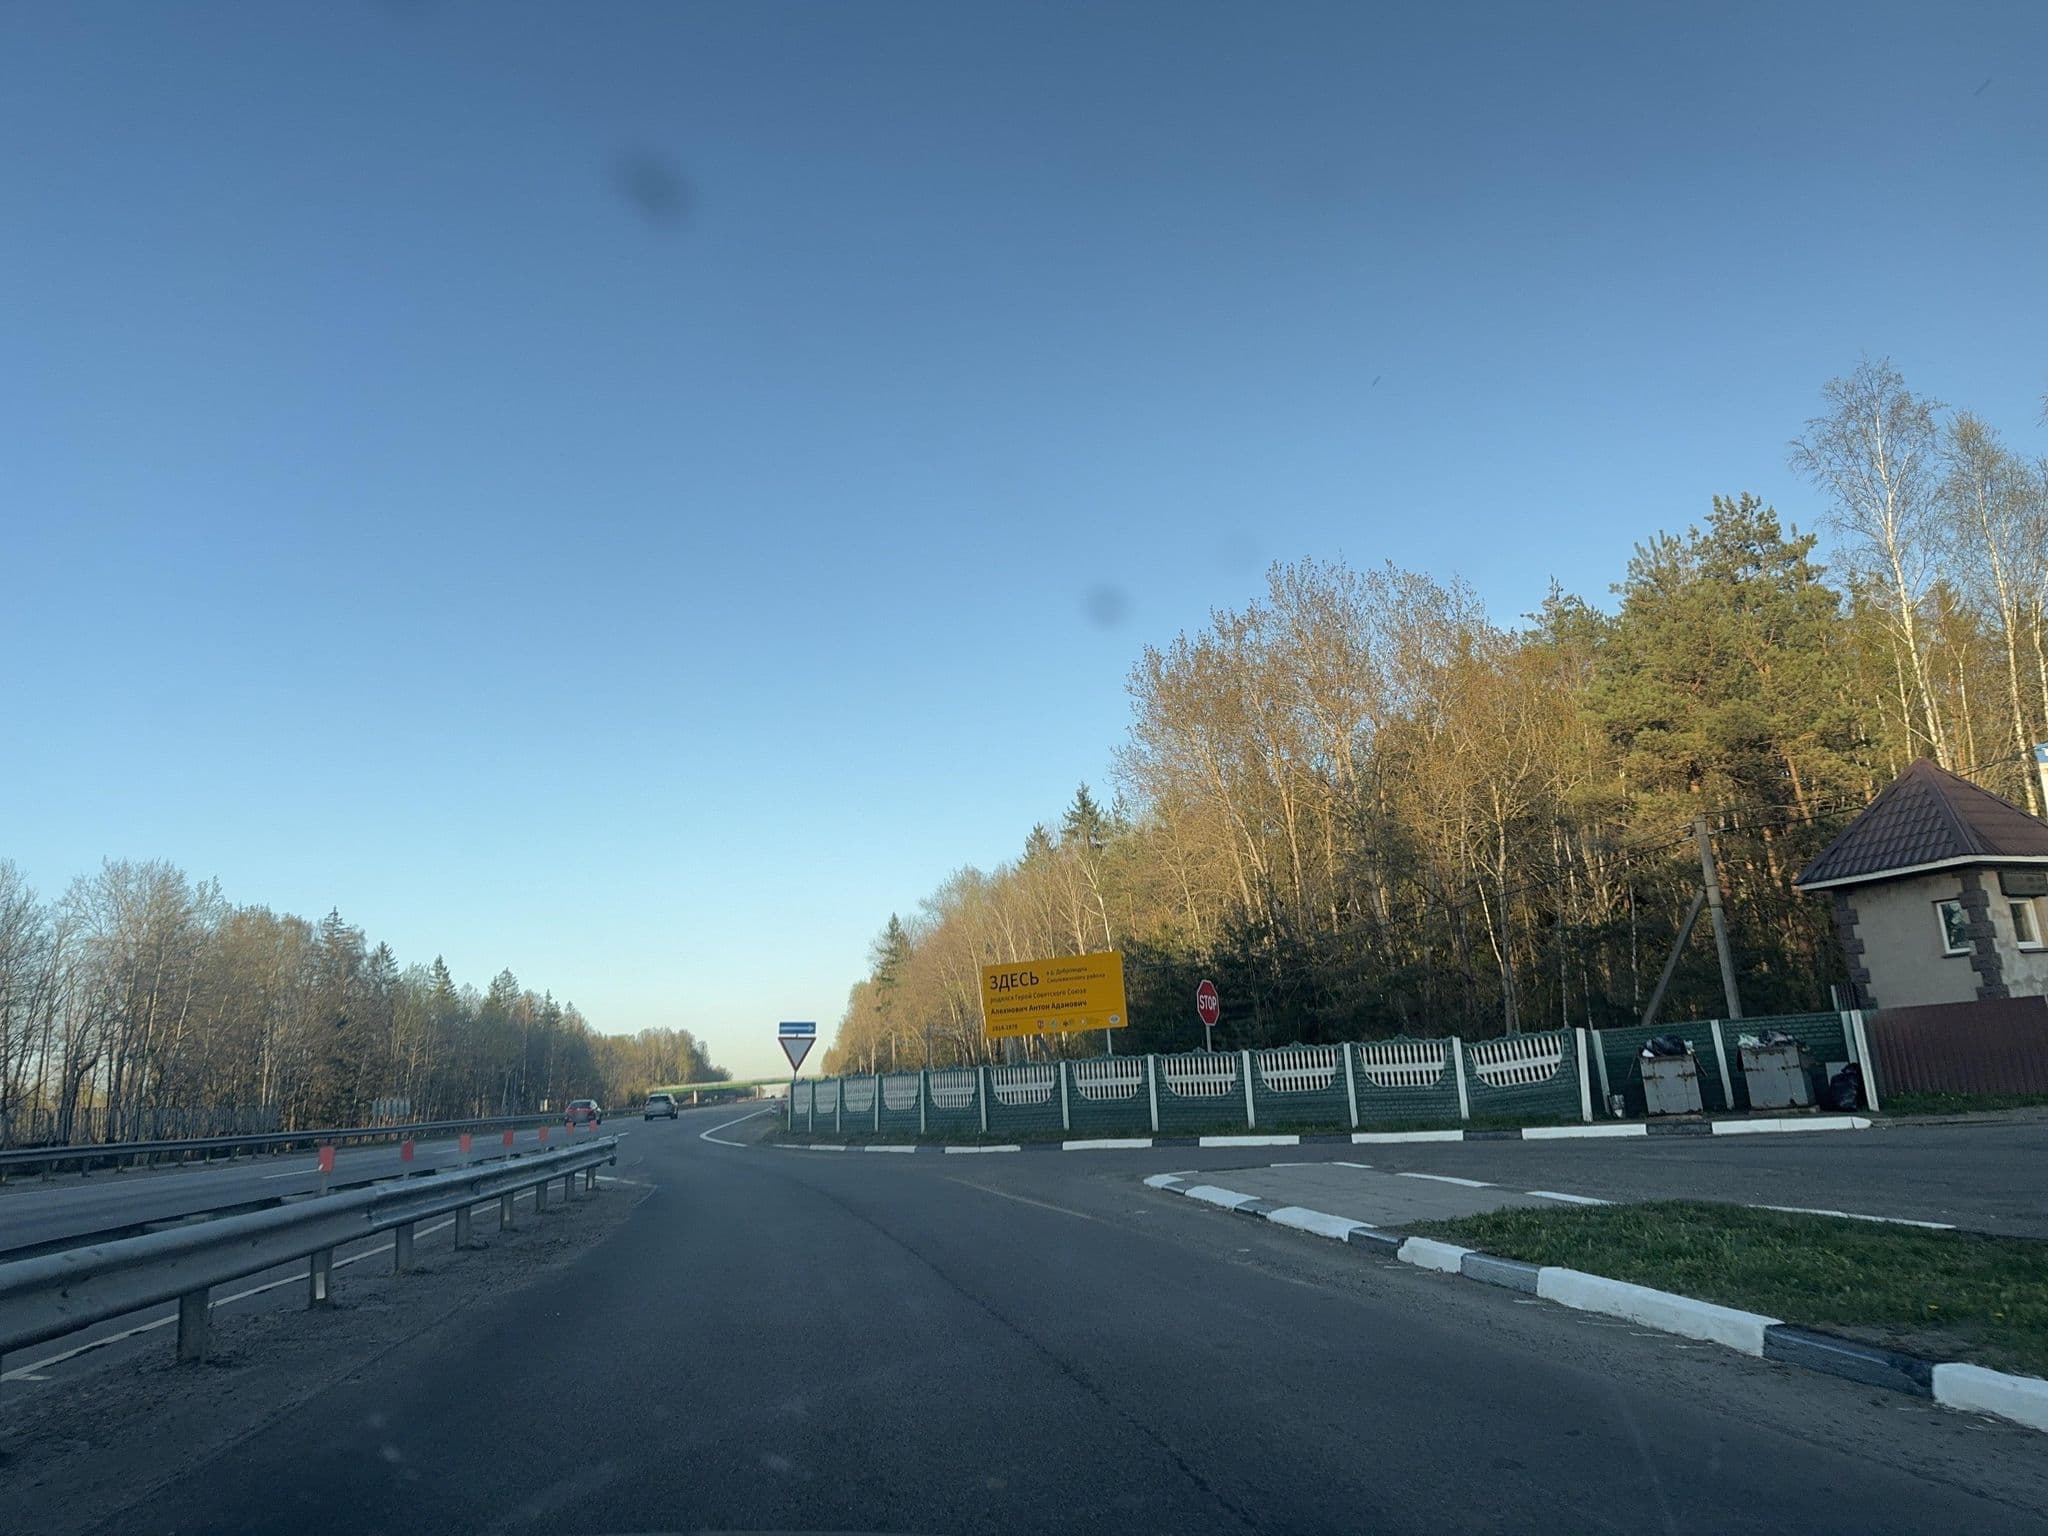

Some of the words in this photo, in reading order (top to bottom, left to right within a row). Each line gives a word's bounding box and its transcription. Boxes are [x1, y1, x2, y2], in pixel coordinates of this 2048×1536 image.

[990, 971, 1040, 992] ЗДЕСЬ
[1032, 989, 1066, 999] Советского
[1066, 987, 1087, 996] Союза
[1028, 1002, 1050, 1012] Антон
[1050, 999, 1088, 1010] Адамович
[1199, 994, 1217, 1010] STOP
